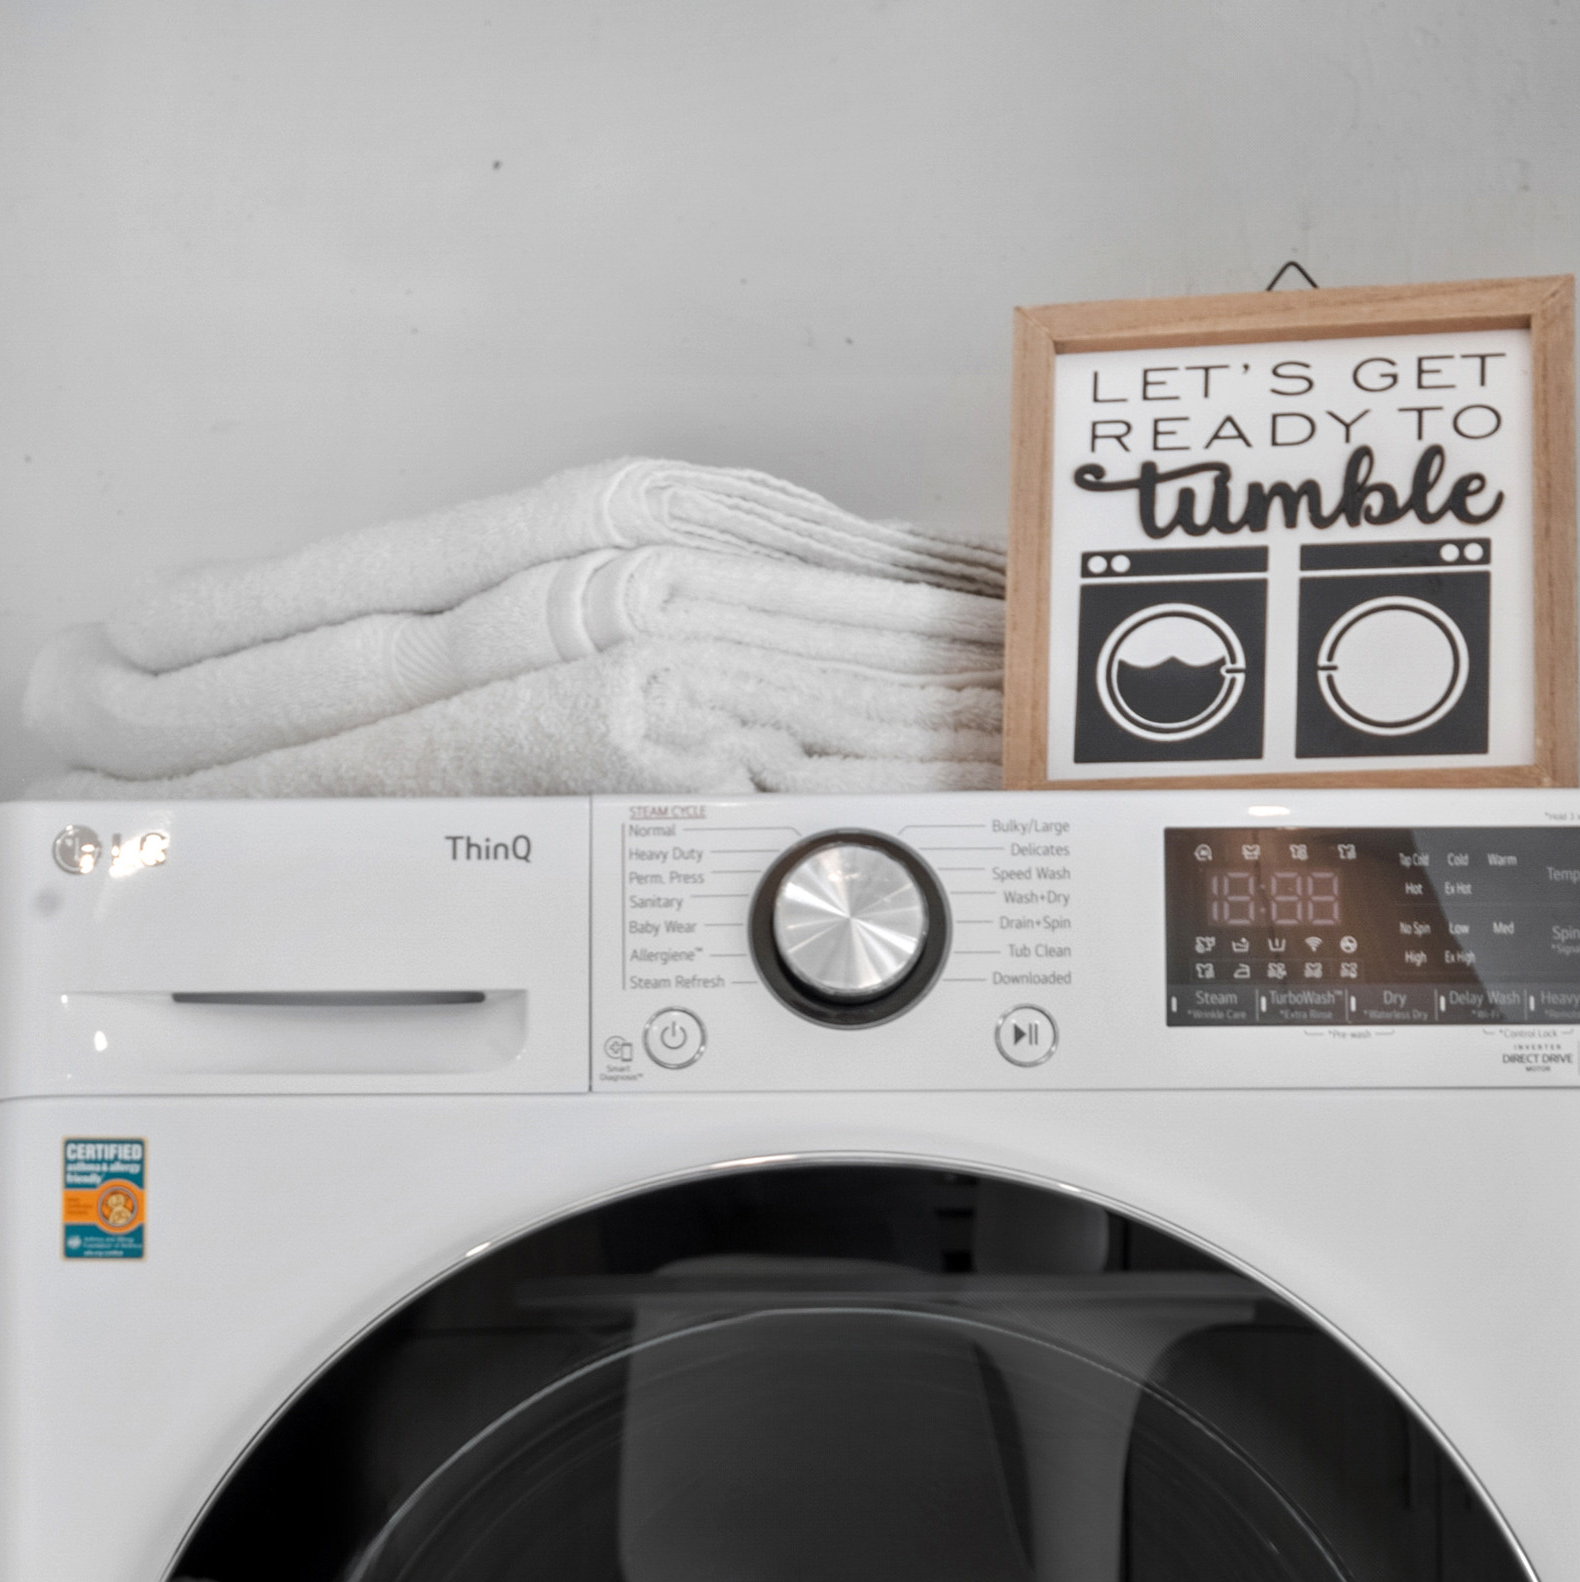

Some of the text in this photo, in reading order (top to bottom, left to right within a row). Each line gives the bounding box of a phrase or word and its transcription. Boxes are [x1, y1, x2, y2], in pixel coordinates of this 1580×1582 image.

[1091, 353, 1506, 403] LET'S GET
[1090, 404, 1502, 453] READY TO
[1073, 444, 1504, 539] tumble
[629, 804, 707, 819] STEAM CYCLE
[628, 823, 676, 837] Normal
[992, 818, 1070, 836] Bulky/Large
[445, 834, 532, 863] ThinQ
[628, 846, 703, 864] Heavy Duty
[1010, 842, 1070, 856] Delicates
[1447, 852, 1469, 866] Cold
[1487, 853, 1517, 866] Warm
[628, 871, 705, 885] Perm. Press
[992, 866, 1070, 882] Speed Wash
[1405, 882, 1423, 895] Hot
[1445, 882, 1472, 895] Ex Hot
[628, 895, 684, 911] Sanitary
[1003, 890, 1070, 907] Wash+Dry
[628, 920, 697, 936] Baby Wear
[999, 916, 1071, 932] Drain+Spin
[1400, 921, 1431, 938] No Spin
[1449, 921, 1469, 934] Low
[1493, 921, 1515, 935] Med
[1552, 925, 1580, 942] Spin
[1008, 943, 1072, 958] Tub Clean
[1405, 950, 1427, 967] High
[1445, 950, 1476, 967] Ex High
[629, 975, 726, 989] Steam Refresh
[992, 971, 1072, 985] Downloaded
[1195, 990, 1238, 1005] Steam
[1383, 990, 1407, 1007] Dry
[1449, 989, 1520, 1007] Delay Wash
[1540, 990, 1580, 1007] Heavy
[1538, 1028, 1558, 1038] Lock
[1502, 1053, 1573, 1064] DIRECT DRIVE
[66, 1143, 142, 1160] CERTIFIED
